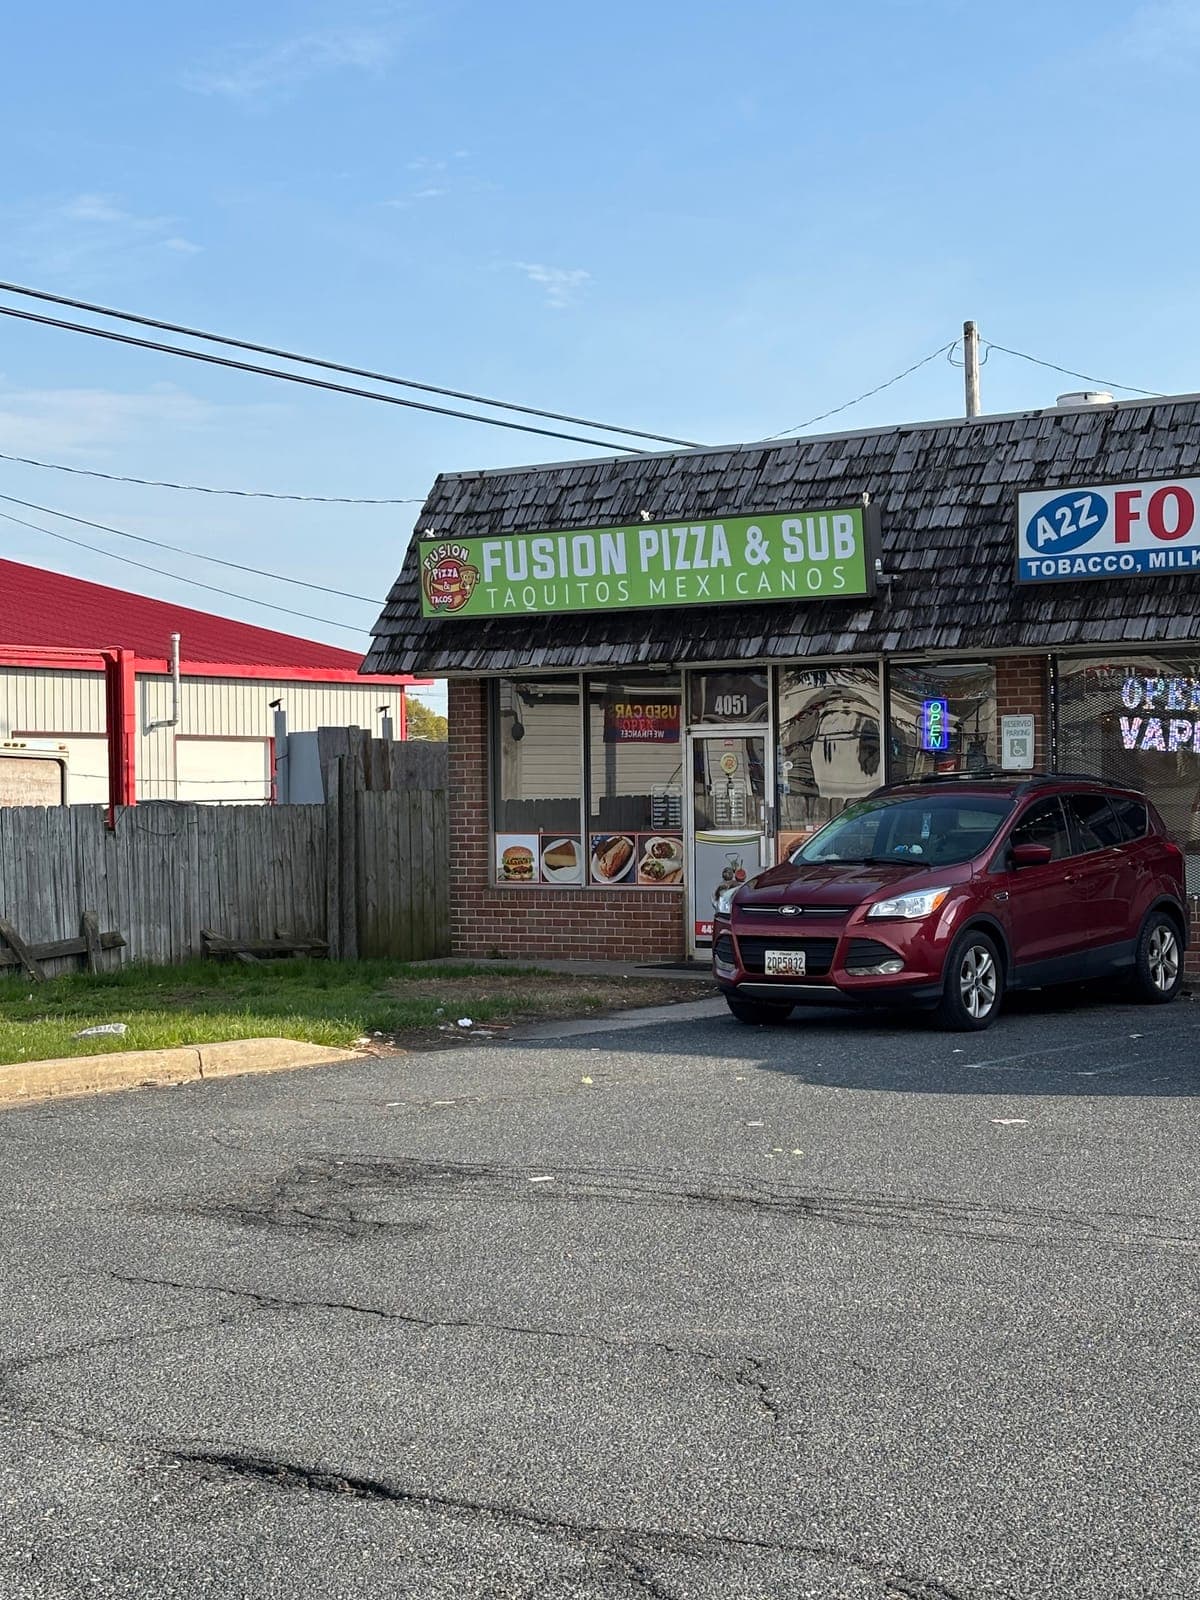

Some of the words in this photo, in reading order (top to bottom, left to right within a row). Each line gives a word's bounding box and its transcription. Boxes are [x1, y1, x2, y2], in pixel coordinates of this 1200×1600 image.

[1036, 496, 1099, 547] A2Z
[1114, 485, 1195, 545] FO
[424, 544, 469, 570] FUSION
[482, 532, 627, 582] FUSION
[638, 524, 732, 572] PIZZA
[744, 525, 771, 565] &
[782, 514, 856, 562] SUB
[1027, 555, 1142, 576] TOBACCO,
[430, 595, 453, 604] TACOS
[486, 581, 629, 610] TAQUITOS
[649, 566, 845, 599] MEXICANOS
[714, 694, 748, 715] 4051
[930, 702, 941, 747] OPEN
[1003, 720, 1032, 728] RESERVED
[1006, 729, 1031, 737] PARKING
